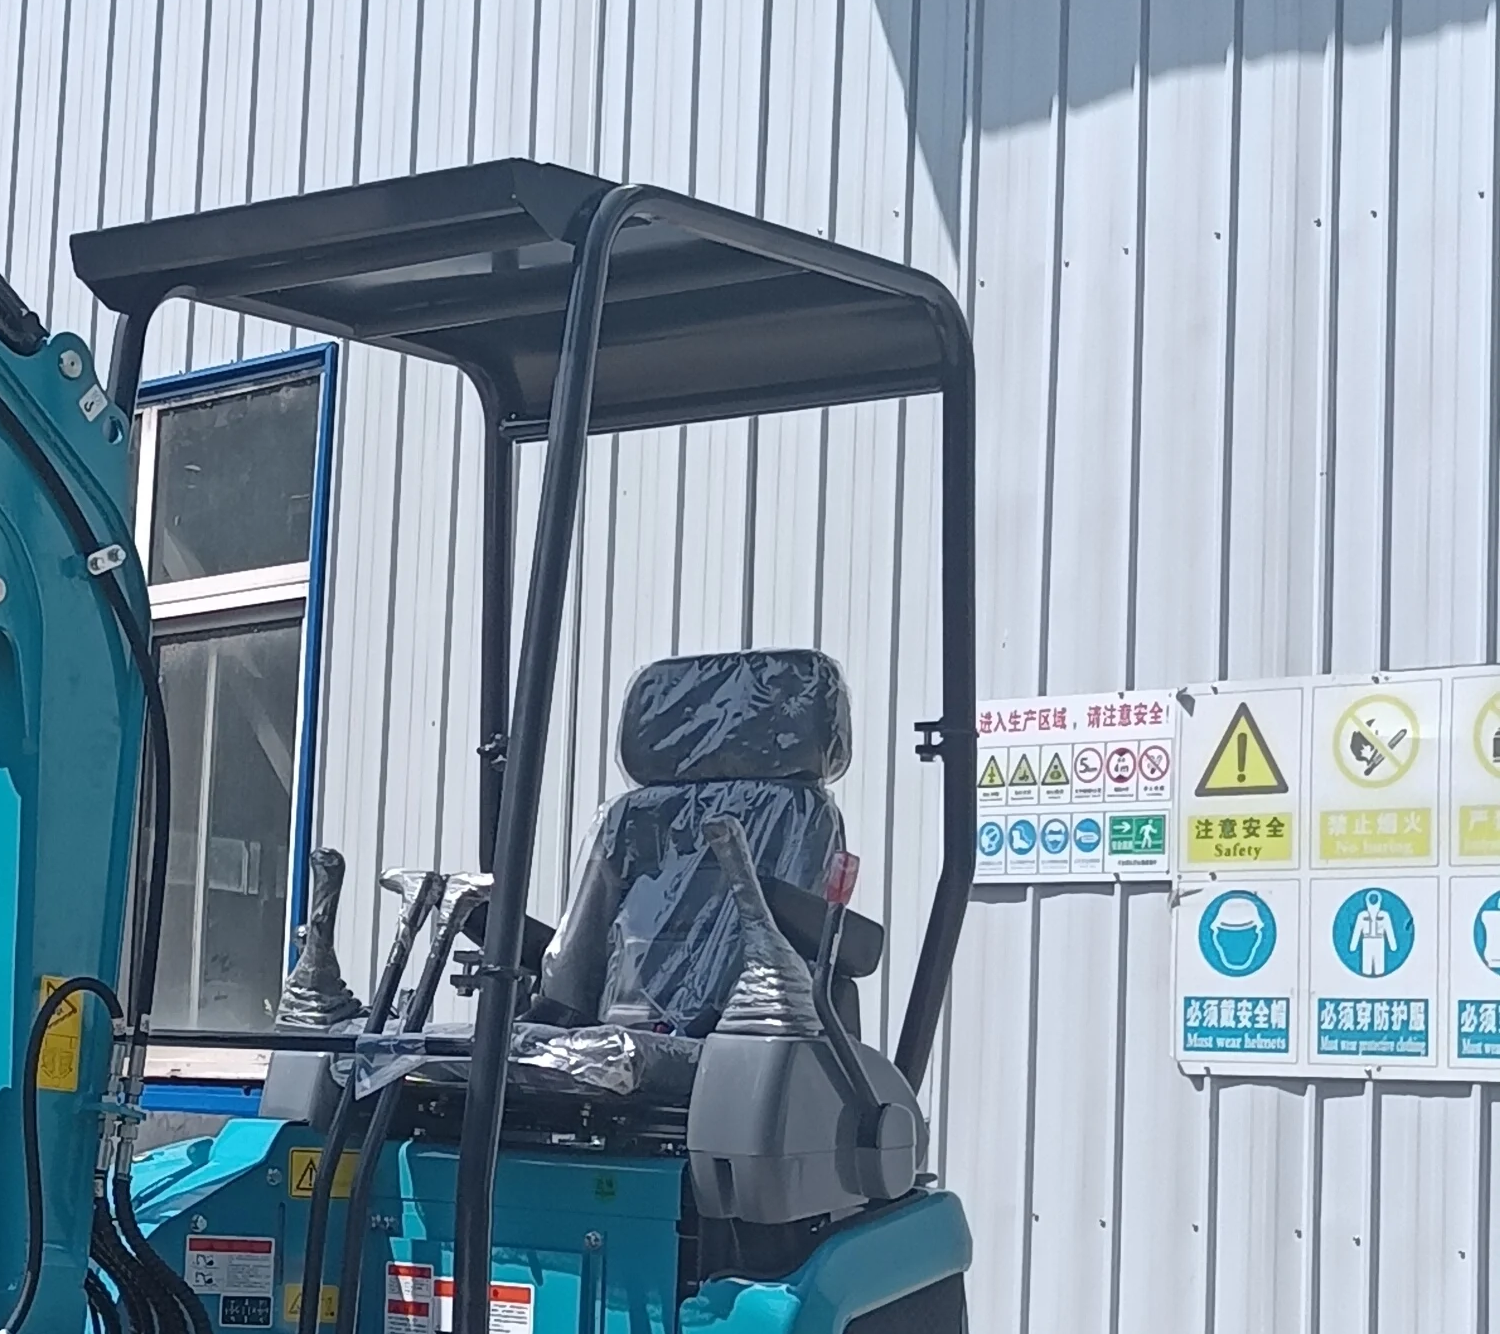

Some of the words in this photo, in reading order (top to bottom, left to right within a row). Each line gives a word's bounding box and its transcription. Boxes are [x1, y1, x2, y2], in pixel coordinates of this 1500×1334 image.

[1195, 816, 1285, 839] 注意安全
[1327, 810, 1422, 836] 禁止烟火
[1468, 809, 1500, 831] 严
[1214, 842, 1262, 860] Safety
[1186, 999, 1287, 1029] 必须戴安全帽
[1320, 1001, 1426, 1031] 必须穿防护服
[1460, 1002, 1500, 1034] 必须
[1186, 1032, 1213, 1048] Must
[1216, 1035, 1242, 1049] wear
[1244, 1033, 1286, 1050] helmets
[1320, 1035, 1338, 1051] Must
